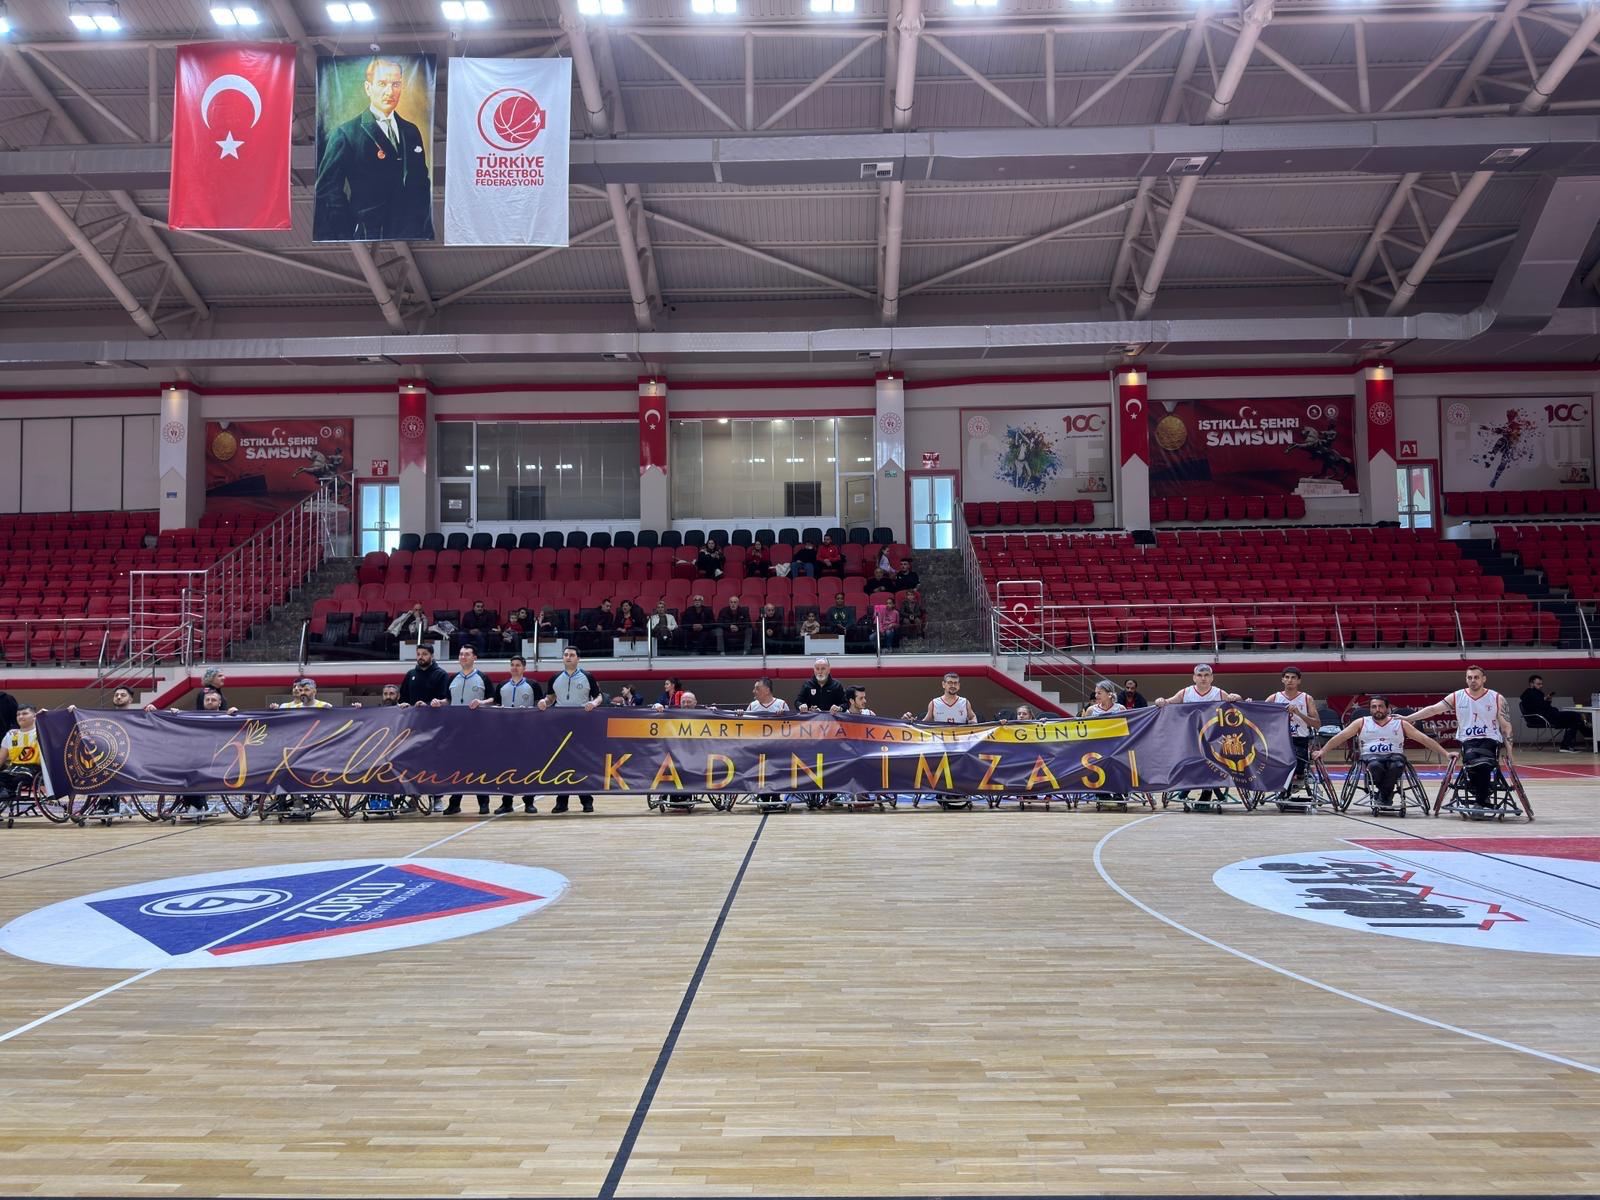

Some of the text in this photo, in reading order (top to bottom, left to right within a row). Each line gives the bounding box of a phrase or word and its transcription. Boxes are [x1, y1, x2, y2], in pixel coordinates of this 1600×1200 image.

[476, 153, 544, 169] TÜRKİYE
[476, 169, 544, 178] BASKETBOL
[475, 178, 544, 187] FEDERASYONU
[1206, 430, 1294, 446] SAMSUN
[246, 446, 313, 460] SAMSUN
[1402, 444, 1417, 454] A1
[374, 460, 387, 468] VIP
[377, 467, 384, 475] B
[649, 720, 1090, 742] 8 MART DÜNYA KADINLAR GÜNÜ
[1465, 725, 1488, 736] otat
[1370, 743, 1393, 753] otat
[603, 745, 1140, 791] KADIN İMZASI
[282, 883, 406, 921] ZORLU
